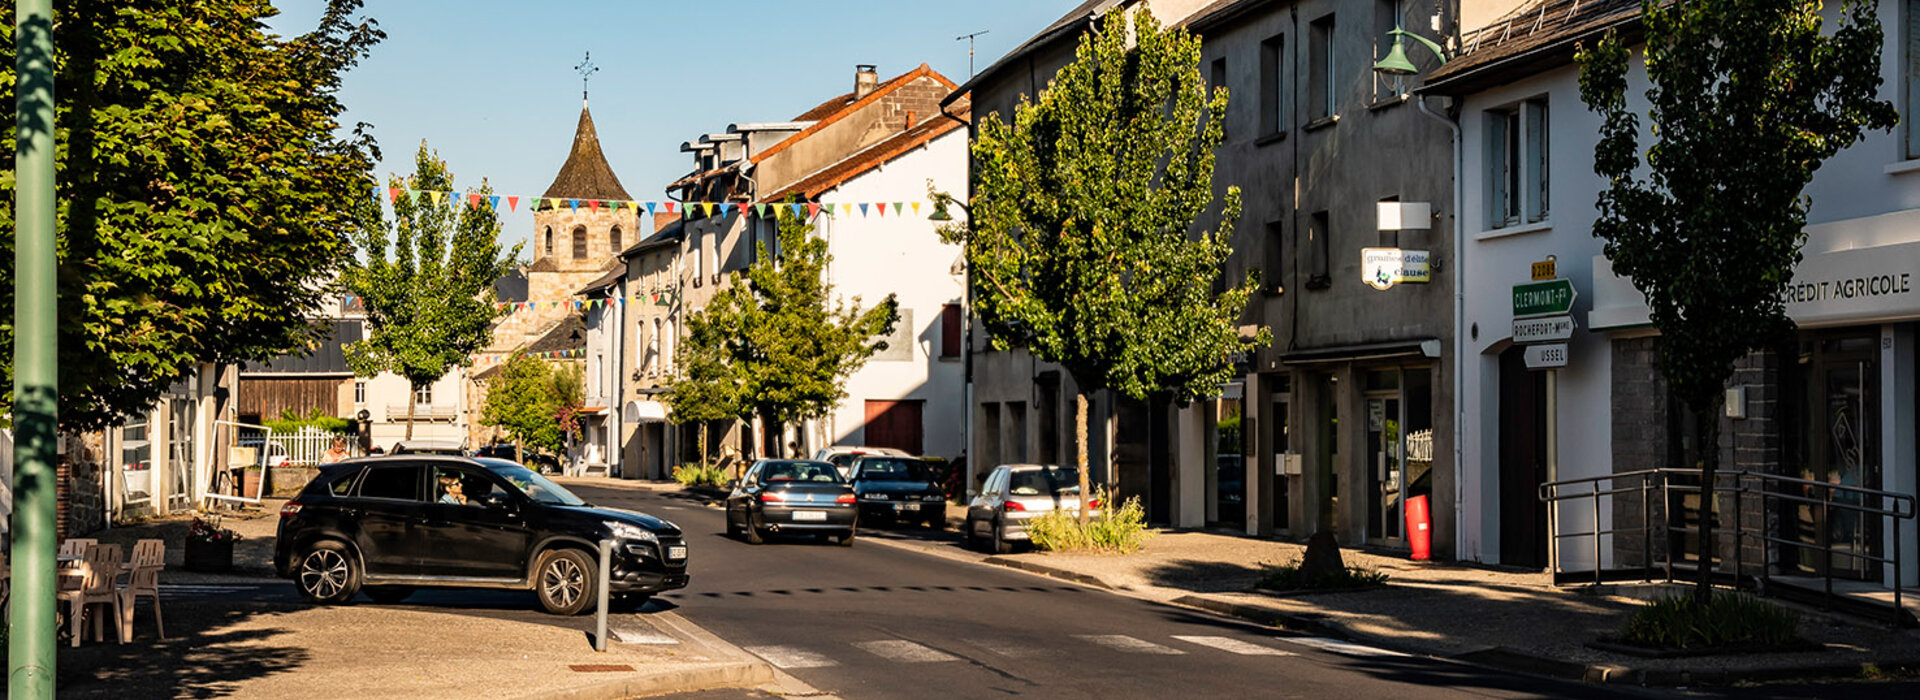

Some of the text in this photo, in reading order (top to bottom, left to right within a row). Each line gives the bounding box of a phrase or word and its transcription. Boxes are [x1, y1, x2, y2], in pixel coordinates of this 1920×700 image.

[1532, 263, 1555, 277] D2089
[1832, 273, 1910, 299] AGRICOLE
[1541, 349, 1564, 362] USSEL
